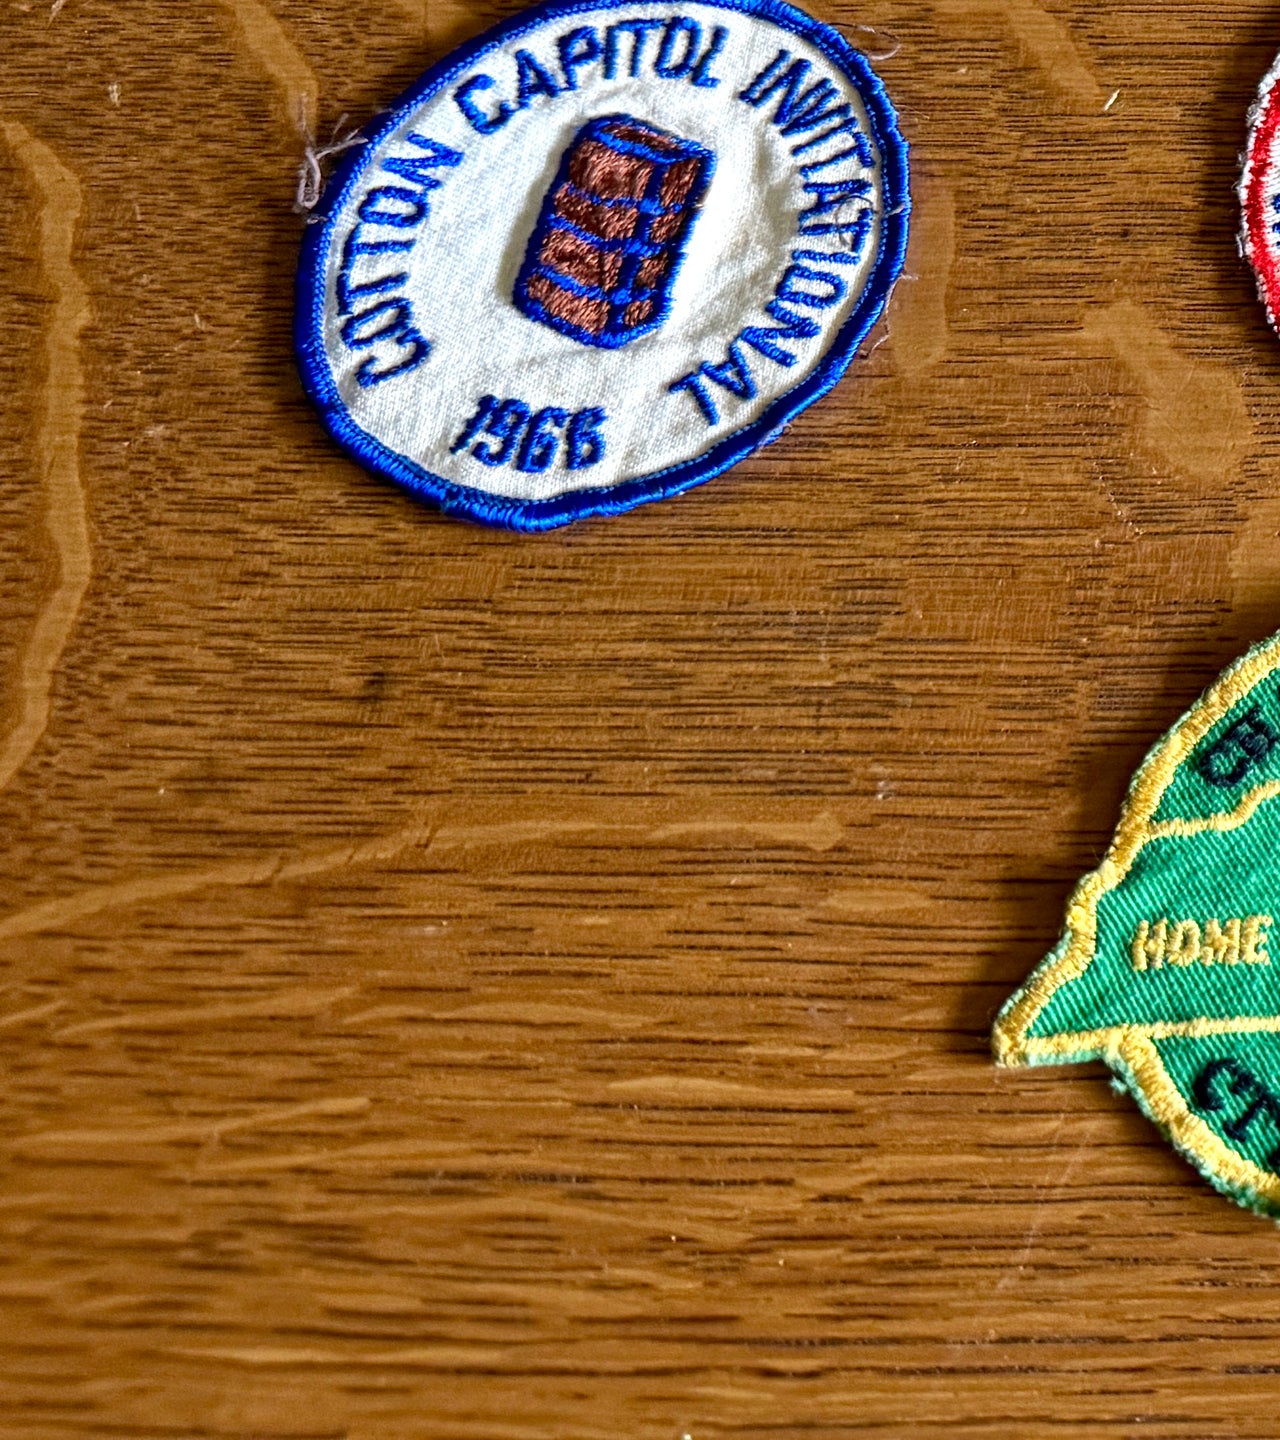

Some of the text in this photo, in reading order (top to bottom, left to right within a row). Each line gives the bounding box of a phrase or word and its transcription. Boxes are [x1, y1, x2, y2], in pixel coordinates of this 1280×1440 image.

[332, 14, 878, 430] COTTON CAPITOL INVITATIONAL
[450, 393, 611, 475] 1966
[1132, 916, 1271, 971] HOME
